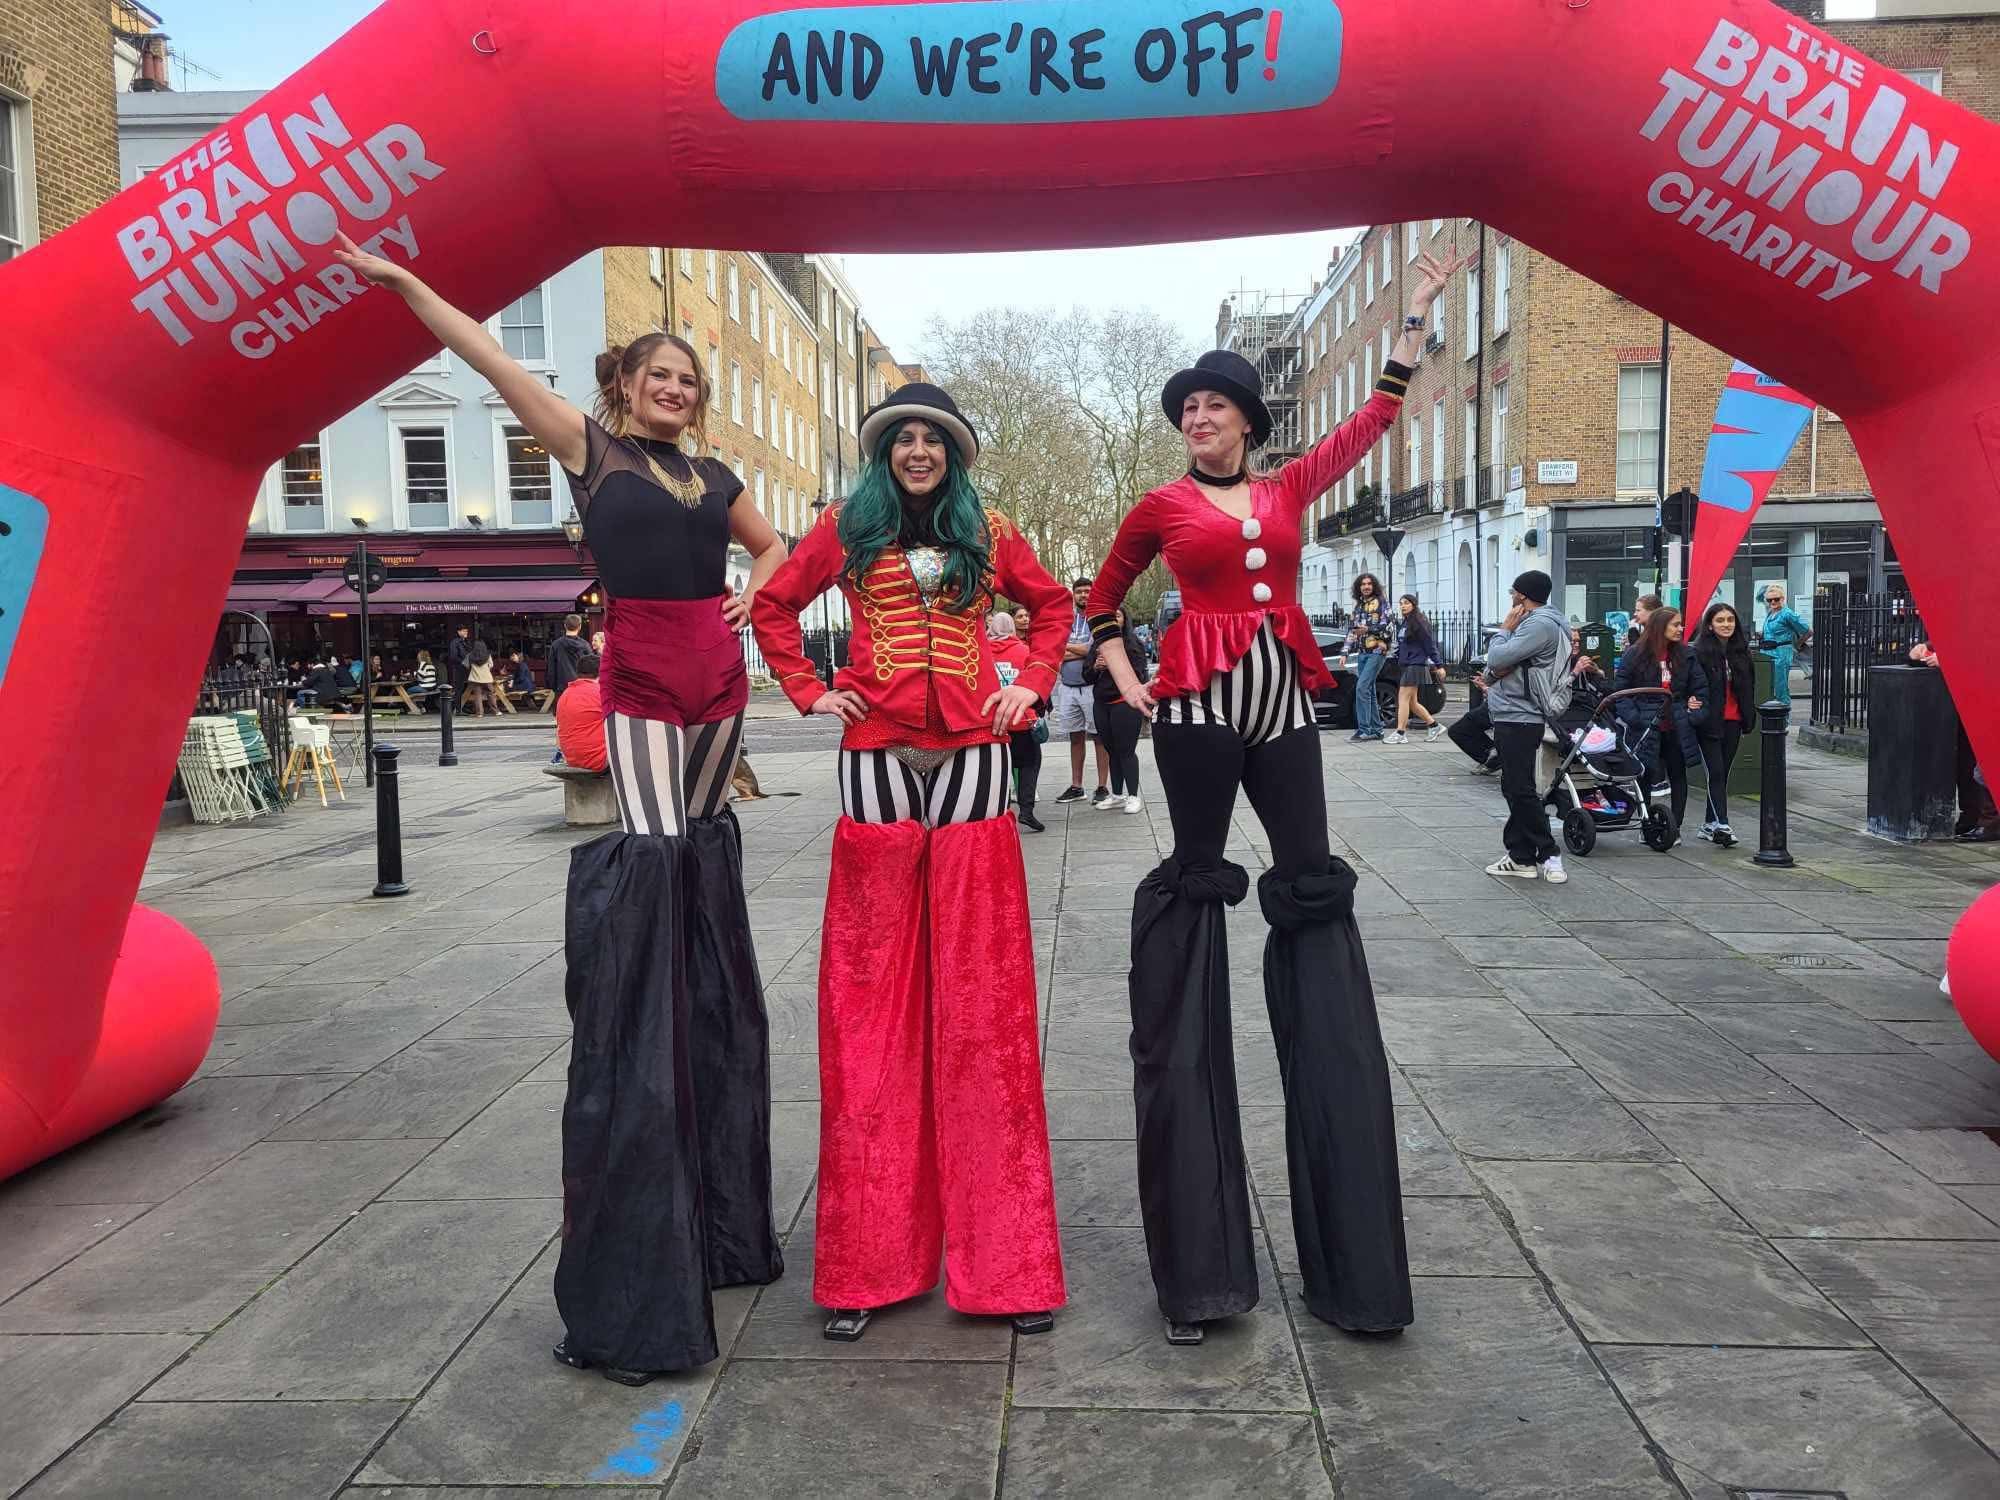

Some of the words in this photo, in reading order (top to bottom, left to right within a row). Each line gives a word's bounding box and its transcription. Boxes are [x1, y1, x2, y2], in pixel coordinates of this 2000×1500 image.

[762, 31, 884, 104] AND
[910, 22, 1105, 97] WE'RE
[1134, 7, 1283, 97] OFF!
[1692, 18, 1960, 200] BRAIN
[1785, 23, 1866, 88] THE
[116, 93, 353, 282] BRAIN
[159, 131, 233, 193] THE
[1638, 67, 1971, 295] TUMOUR
[131, 123, 447, 347] TUMOUR
[230, 214, 421, 359] CHARTY
[1647, 171, 1873, 301] CHARITY
